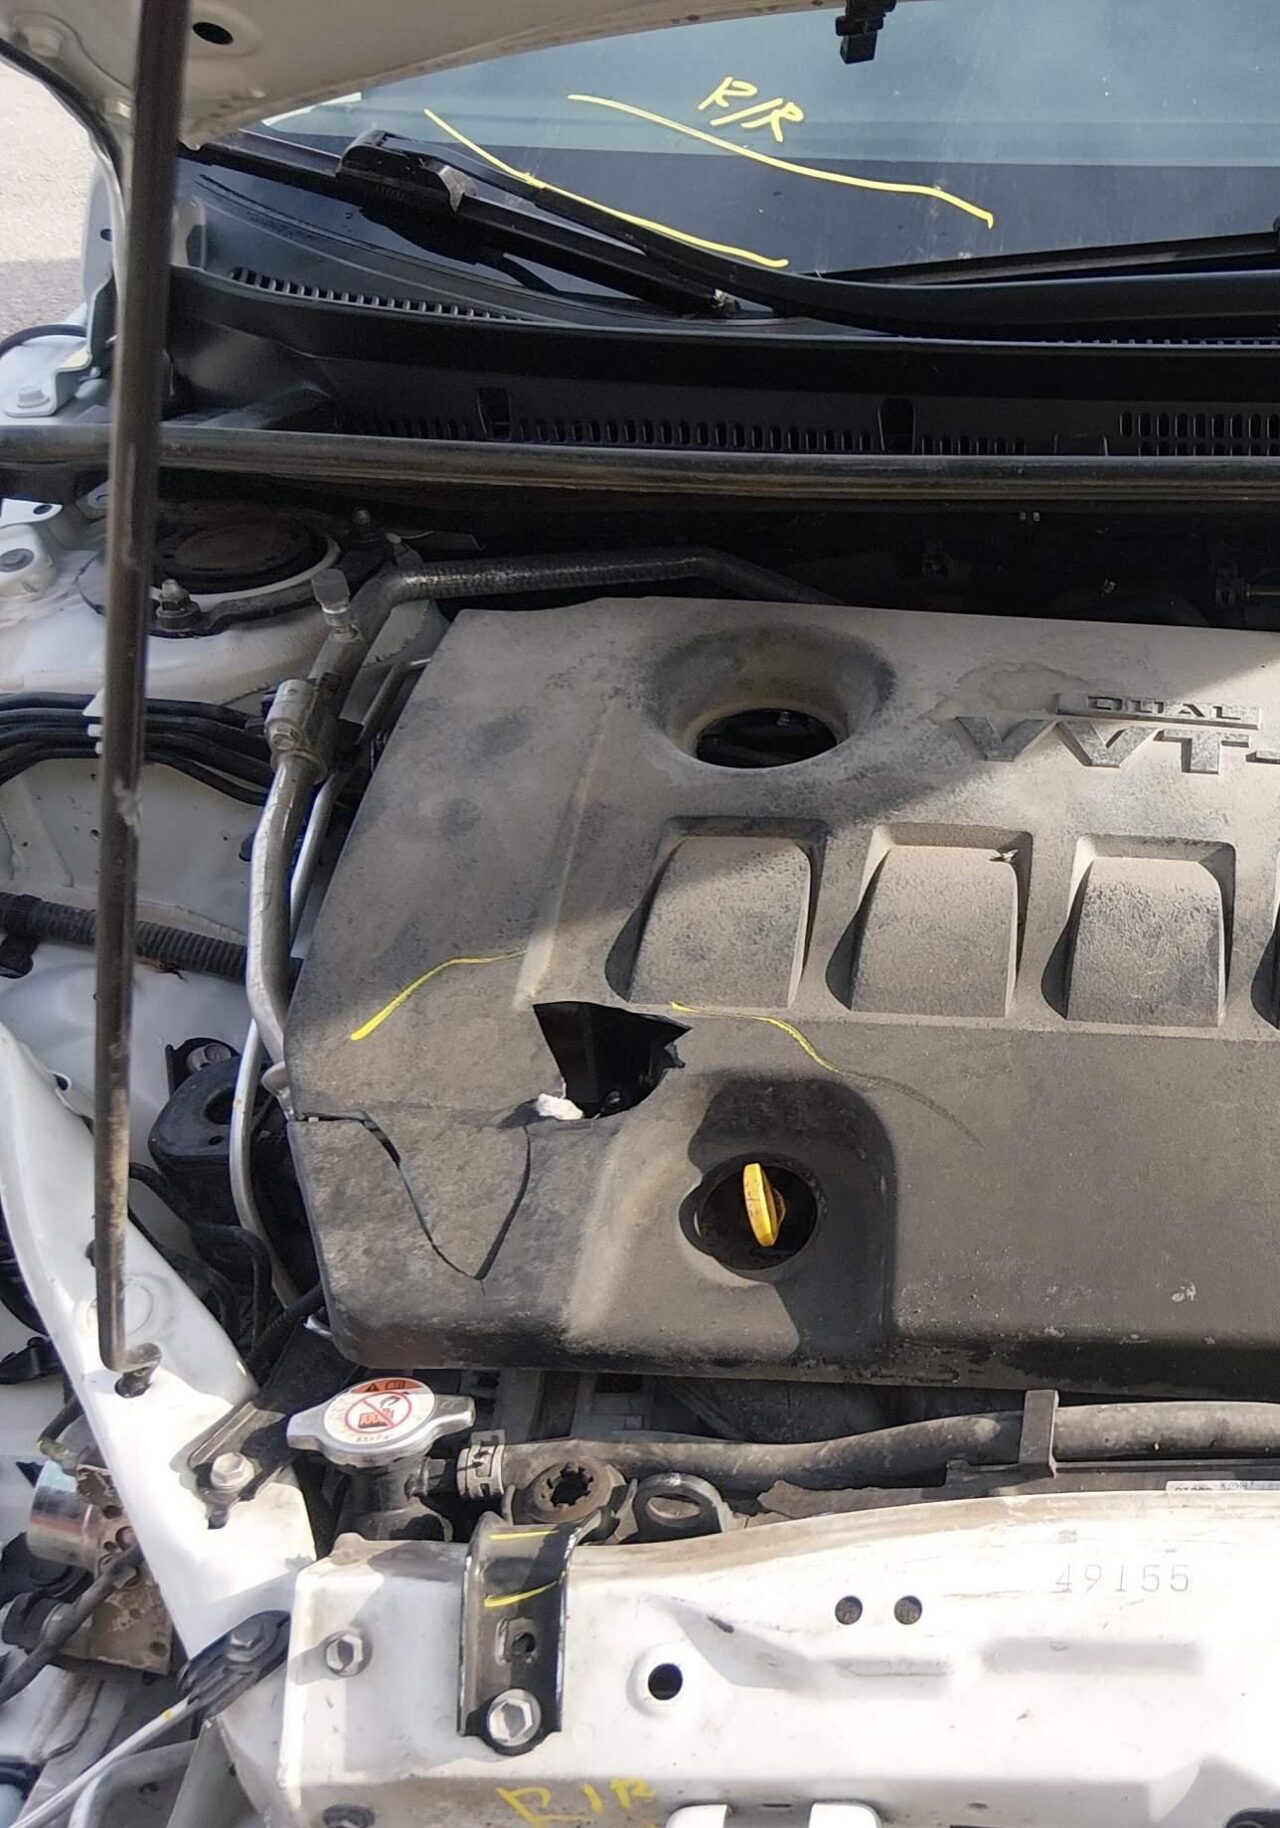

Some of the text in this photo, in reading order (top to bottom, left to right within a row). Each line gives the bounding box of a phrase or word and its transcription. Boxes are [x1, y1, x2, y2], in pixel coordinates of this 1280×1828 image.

[698, 76, 804, 142] R/R
[1085, 694, 1243, 722] DUAL
[1054, 1562, 1190, 1594] 49155
